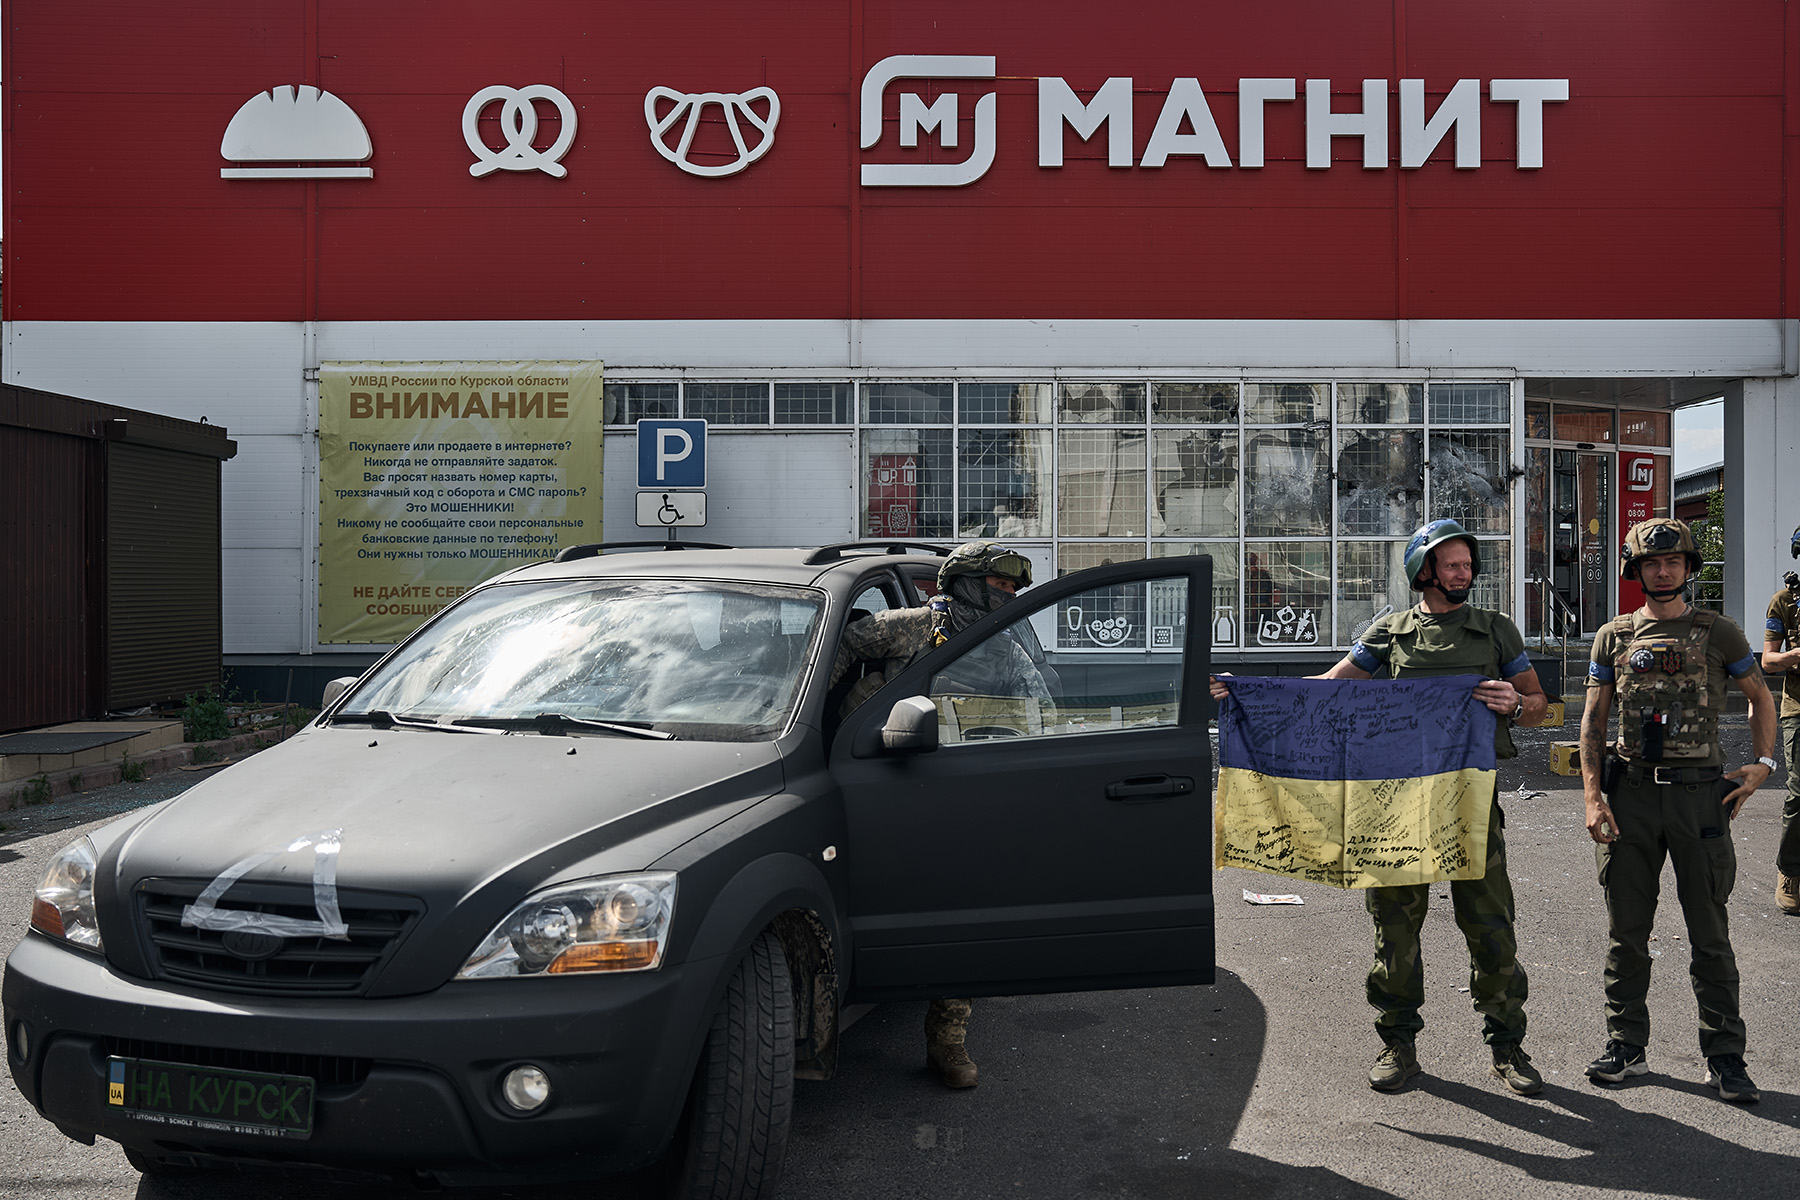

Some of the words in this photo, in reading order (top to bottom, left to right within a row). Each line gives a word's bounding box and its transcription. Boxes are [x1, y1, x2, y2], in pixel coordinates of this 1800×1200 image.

[1038, 77, 1570, 170] МАГНИТ
[350, 376, 388, 388] УМВД
[391, 376, 438, 387] России
[441, 378, 456, 386] по
[460, 375, 513, 389] Курской
[517, 375, 569, 386] области
[350, 392, 569, 419] ВНИМАНИЕ
[349, 441, 410, 453] Покупаете
[413, 443, 434, 451] или
[438, 442, 492, 453] продаете
[495, 442, 502, 451] в
[505, 440, 572, 453] интернете?
[656, 428, 693, 480] P
[364, 457, 411, 468] Никогда
[414, 458, 428, 467] не
[431, 455, 504, 469] отправляйте
[508, 458, 557, 468] задаток.
[364, 472, 385, 482] Вас
[388, 474, 428, 484] просят
[431, 474, 476, 482] назвать
[479, 474, 516, 484] номер
[519, 474, 558, 484] карты,
[335, 487, 410, 498] трехзначный
[413, 489, 434, 499] код
[437, 489, 444, 497] с
[447, 487, 495, 499] оборота
[498, 489, 505, 497] и
[508, 487, 535, 497] СМС
[538, 486, 587, 499] пароль?
[406, 503, 427, 513] Это
[430, 503, 515, 513] МОШЕННИКИ!
[1628, 509, 1646, 517] 08:00
[337, 518, 381, 530] Никому
[384, 520, 398, 528] не
[401, 517, 466, 530] сообщайте
[469, 520, 496, 528] свои
[499, 520, 584, 530] персональные
[362, 532, 430, 544] банковские
[433, 535, 477, 545] данные
[480, 535, 494, 543] по
[497, 533, 558, 545] телефону!
[357, 549, 381, 559] Они
[384, 551, 423, 561] нужны
[426, 550, 466, 559] только
[469, 549, 562, 559] МОШЕННИКАМ
[353, 586, 374, 598] НЕ
[377, 583, 431, 600] ДАЙТЕ
[435, 586, 472, 598] СЕБ
[110, 1088, 123, 1100] UA
[130, 1069, 173, 1109] НА
[189, 1075, 305, 1124] КУРСК
